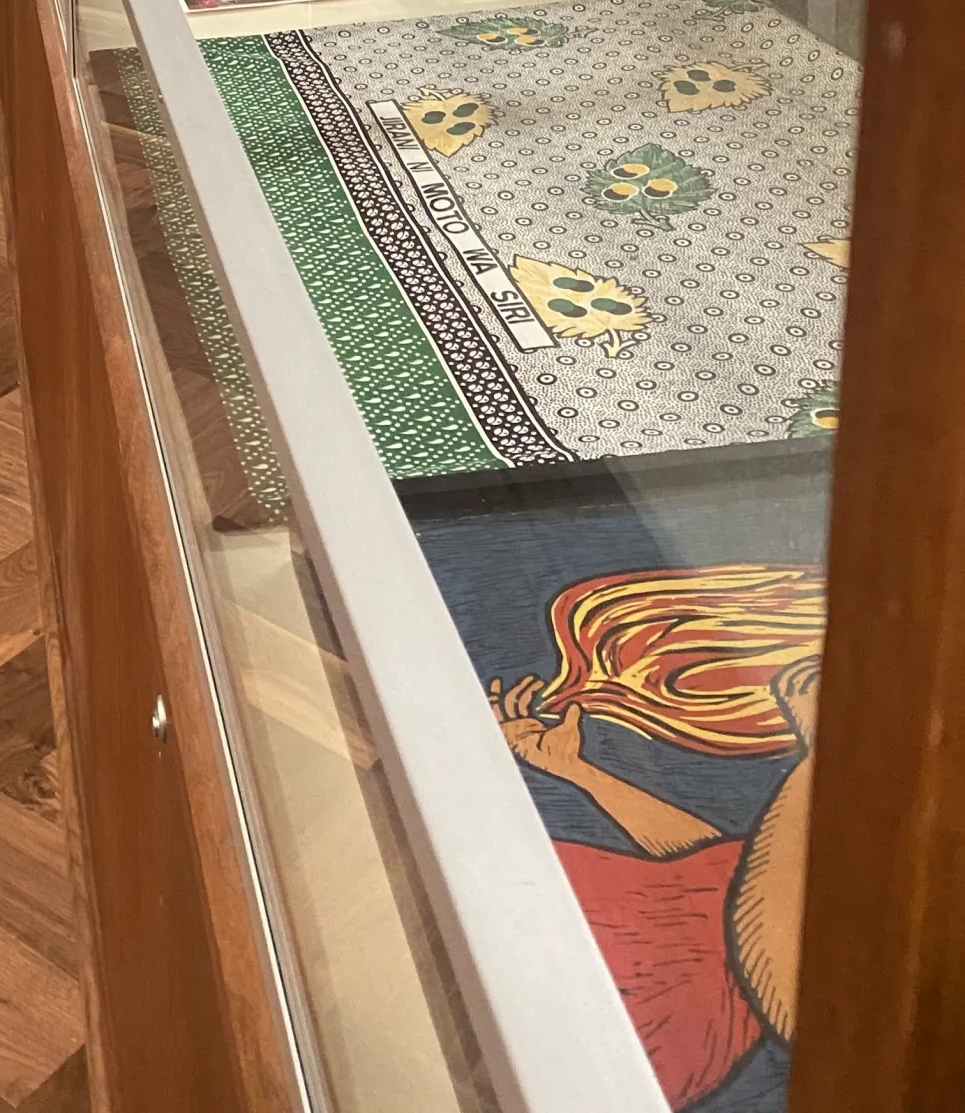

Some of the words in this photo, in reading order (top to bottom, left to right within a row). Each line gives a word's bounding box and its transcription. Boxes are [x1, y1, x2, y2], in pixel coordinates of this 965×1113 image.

[380, 116, 421, 150] JIRANI
[406, 161, 435, 173] NI
[421, 182, 470, 234] MOTO
[463, 248, 499, 276] WA
[490, 290, 536, 324] SIRI
